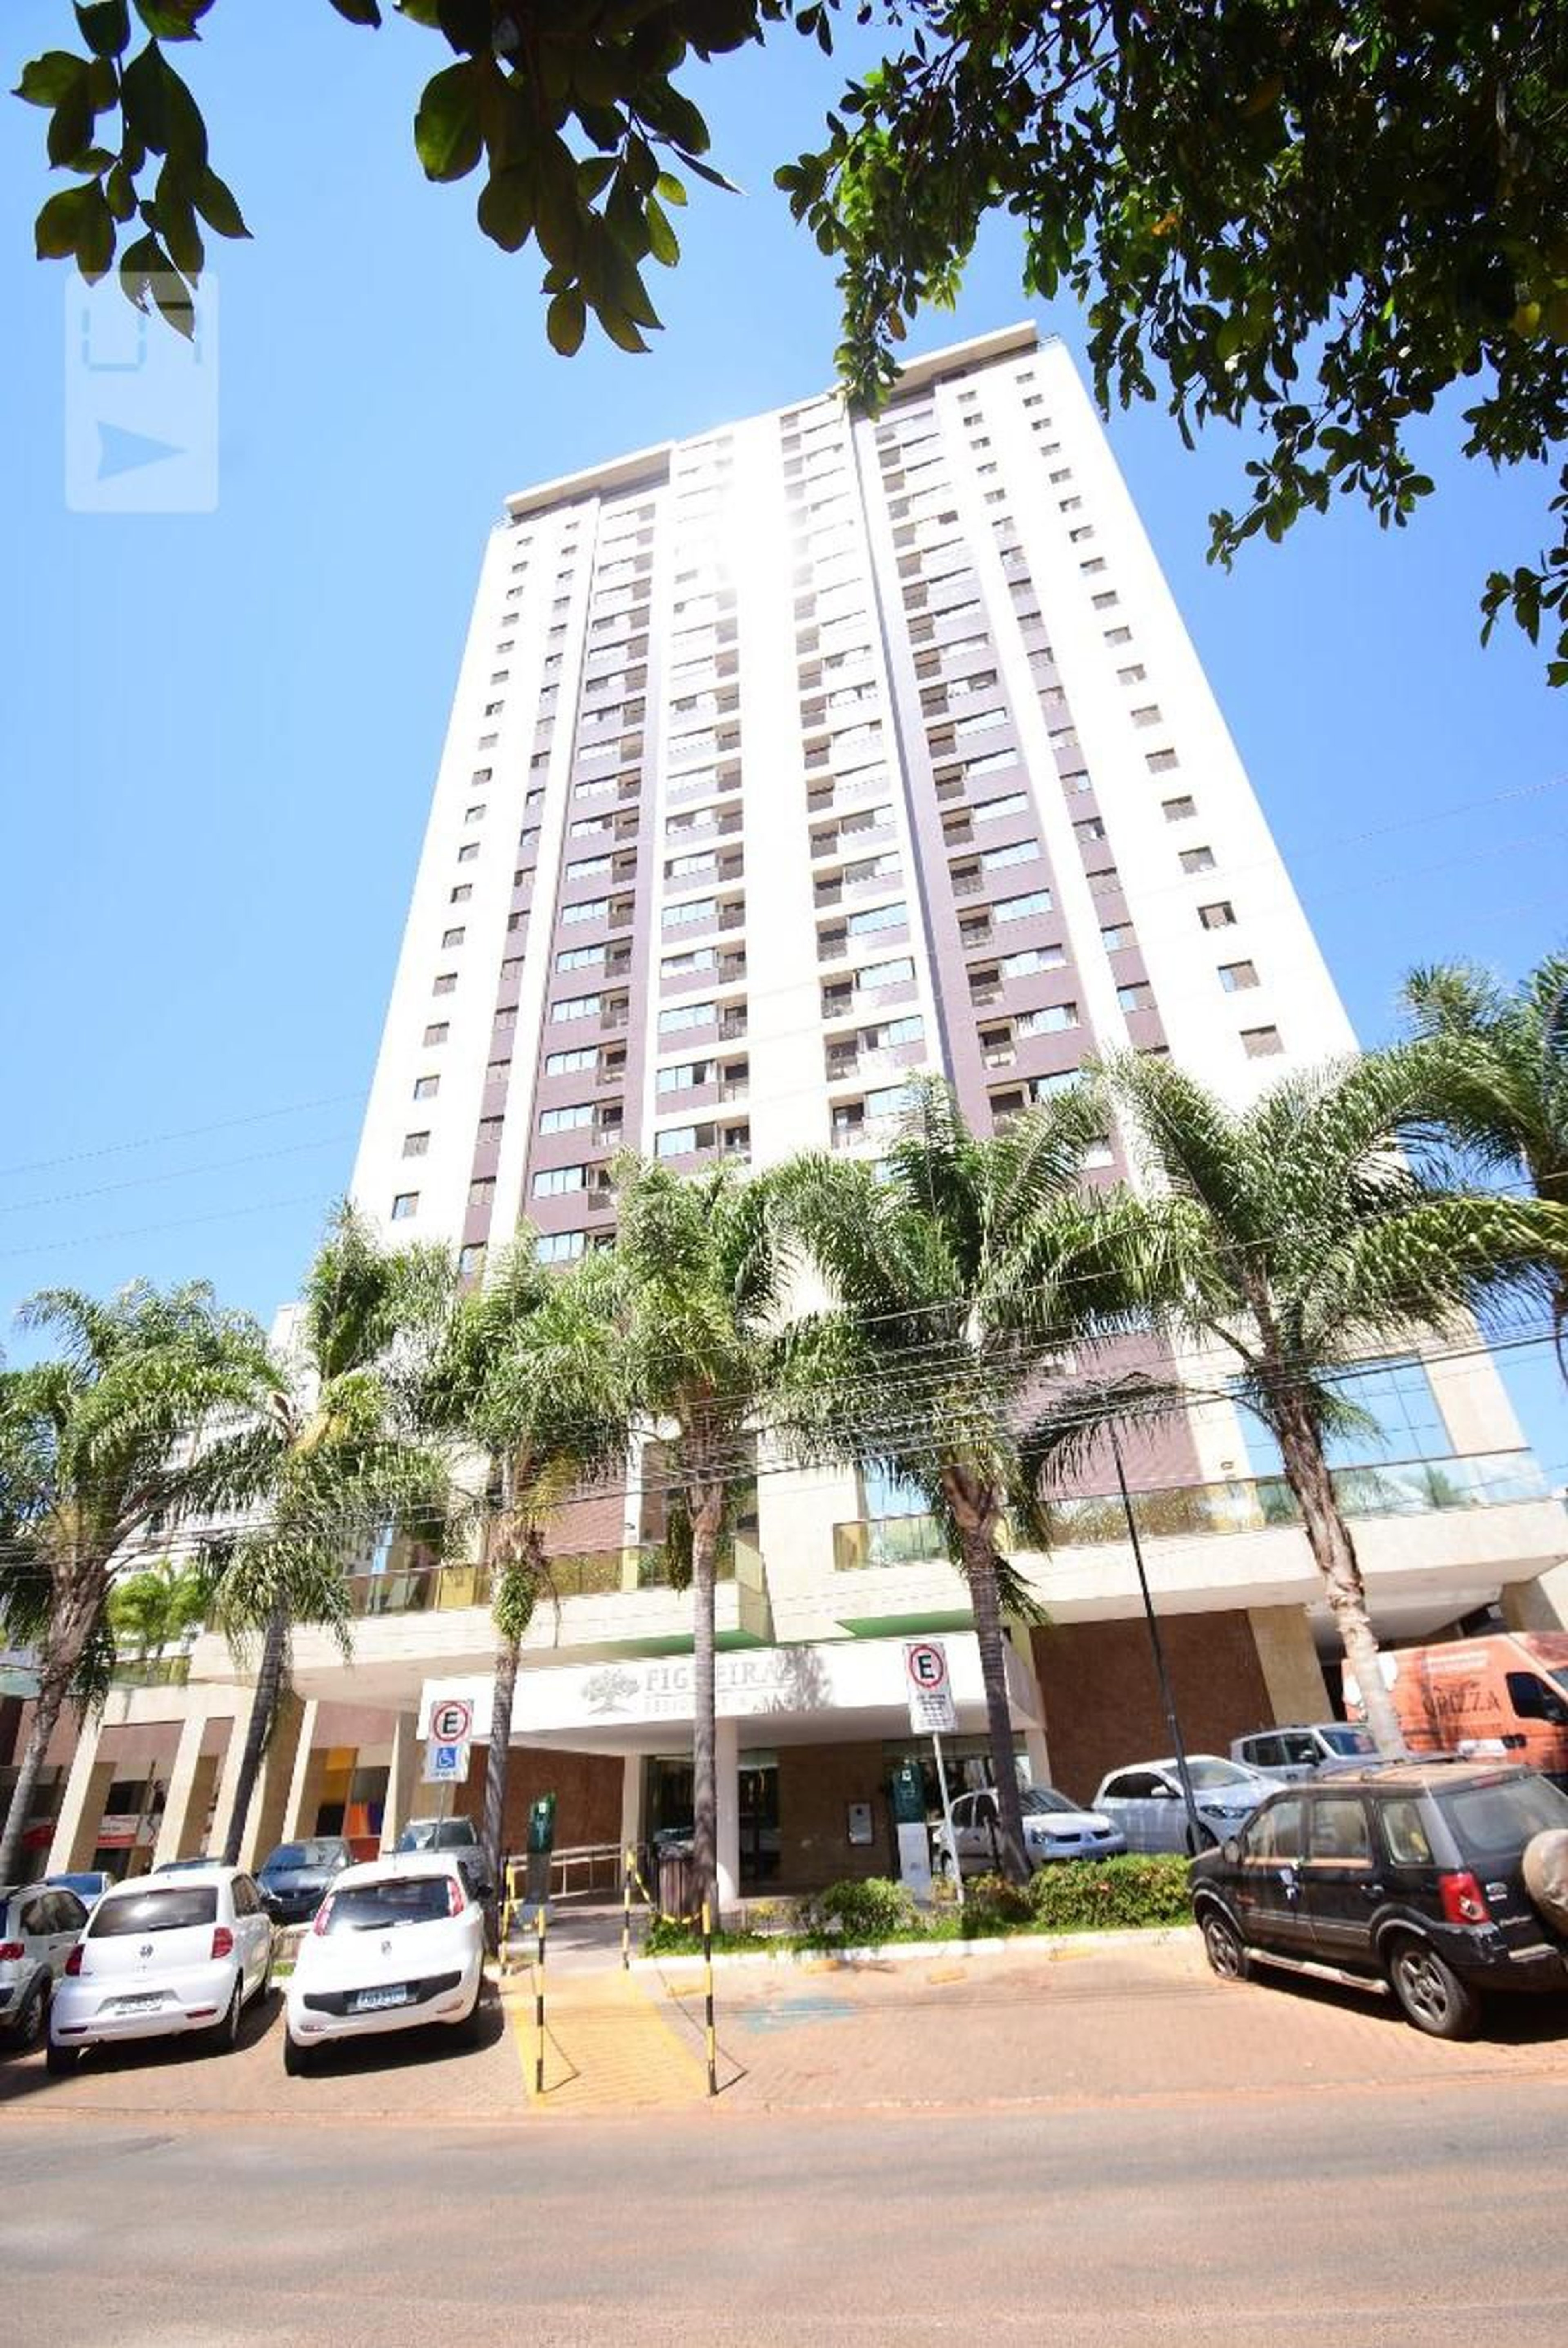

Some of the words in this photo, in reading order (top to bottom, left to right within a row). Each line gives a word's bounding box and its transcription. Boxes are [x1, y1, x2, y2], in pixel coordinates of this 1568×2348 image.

[645, 1661, 785, 1691] FIGEIRA
[918, 1655, 934, 1679] E
[443, 1711, 458, 1734] E
